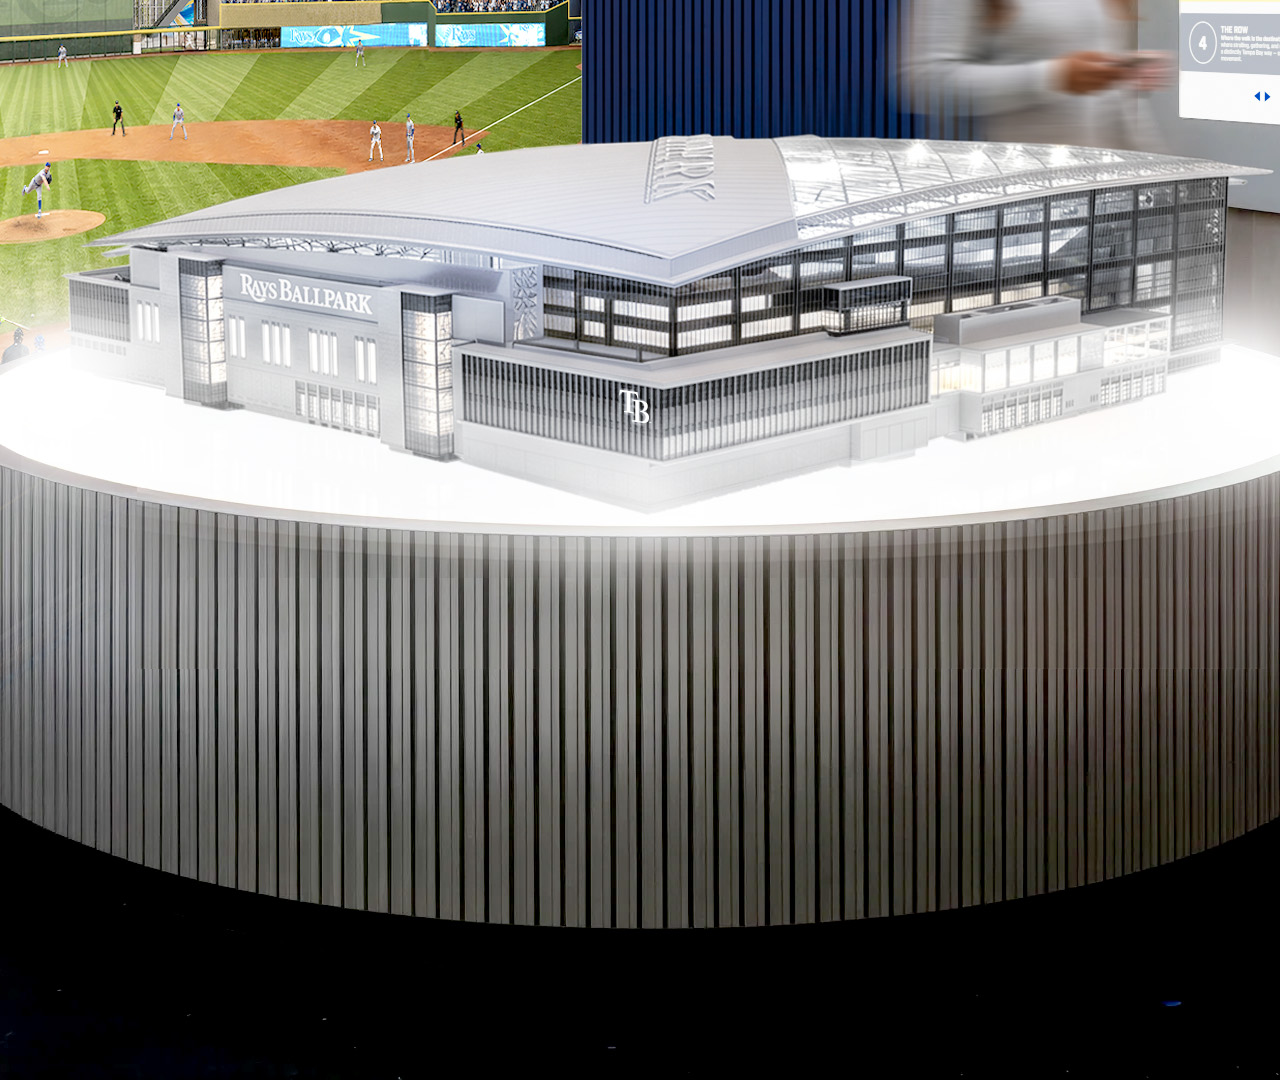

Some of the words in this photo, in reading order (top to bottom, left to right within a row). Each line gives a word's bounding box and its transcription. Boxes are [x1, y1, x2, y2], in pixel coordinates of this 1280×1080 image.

[1221, 26, 1233, 34] THE
[1234, 26, 1248, 34] ROW
[1198, 36, 1207, 50] 4
[240, 273, 278, 302] RAYS
[278, 279, 373, 315] BALLPARK
[619, 390, 650, 423] TB
